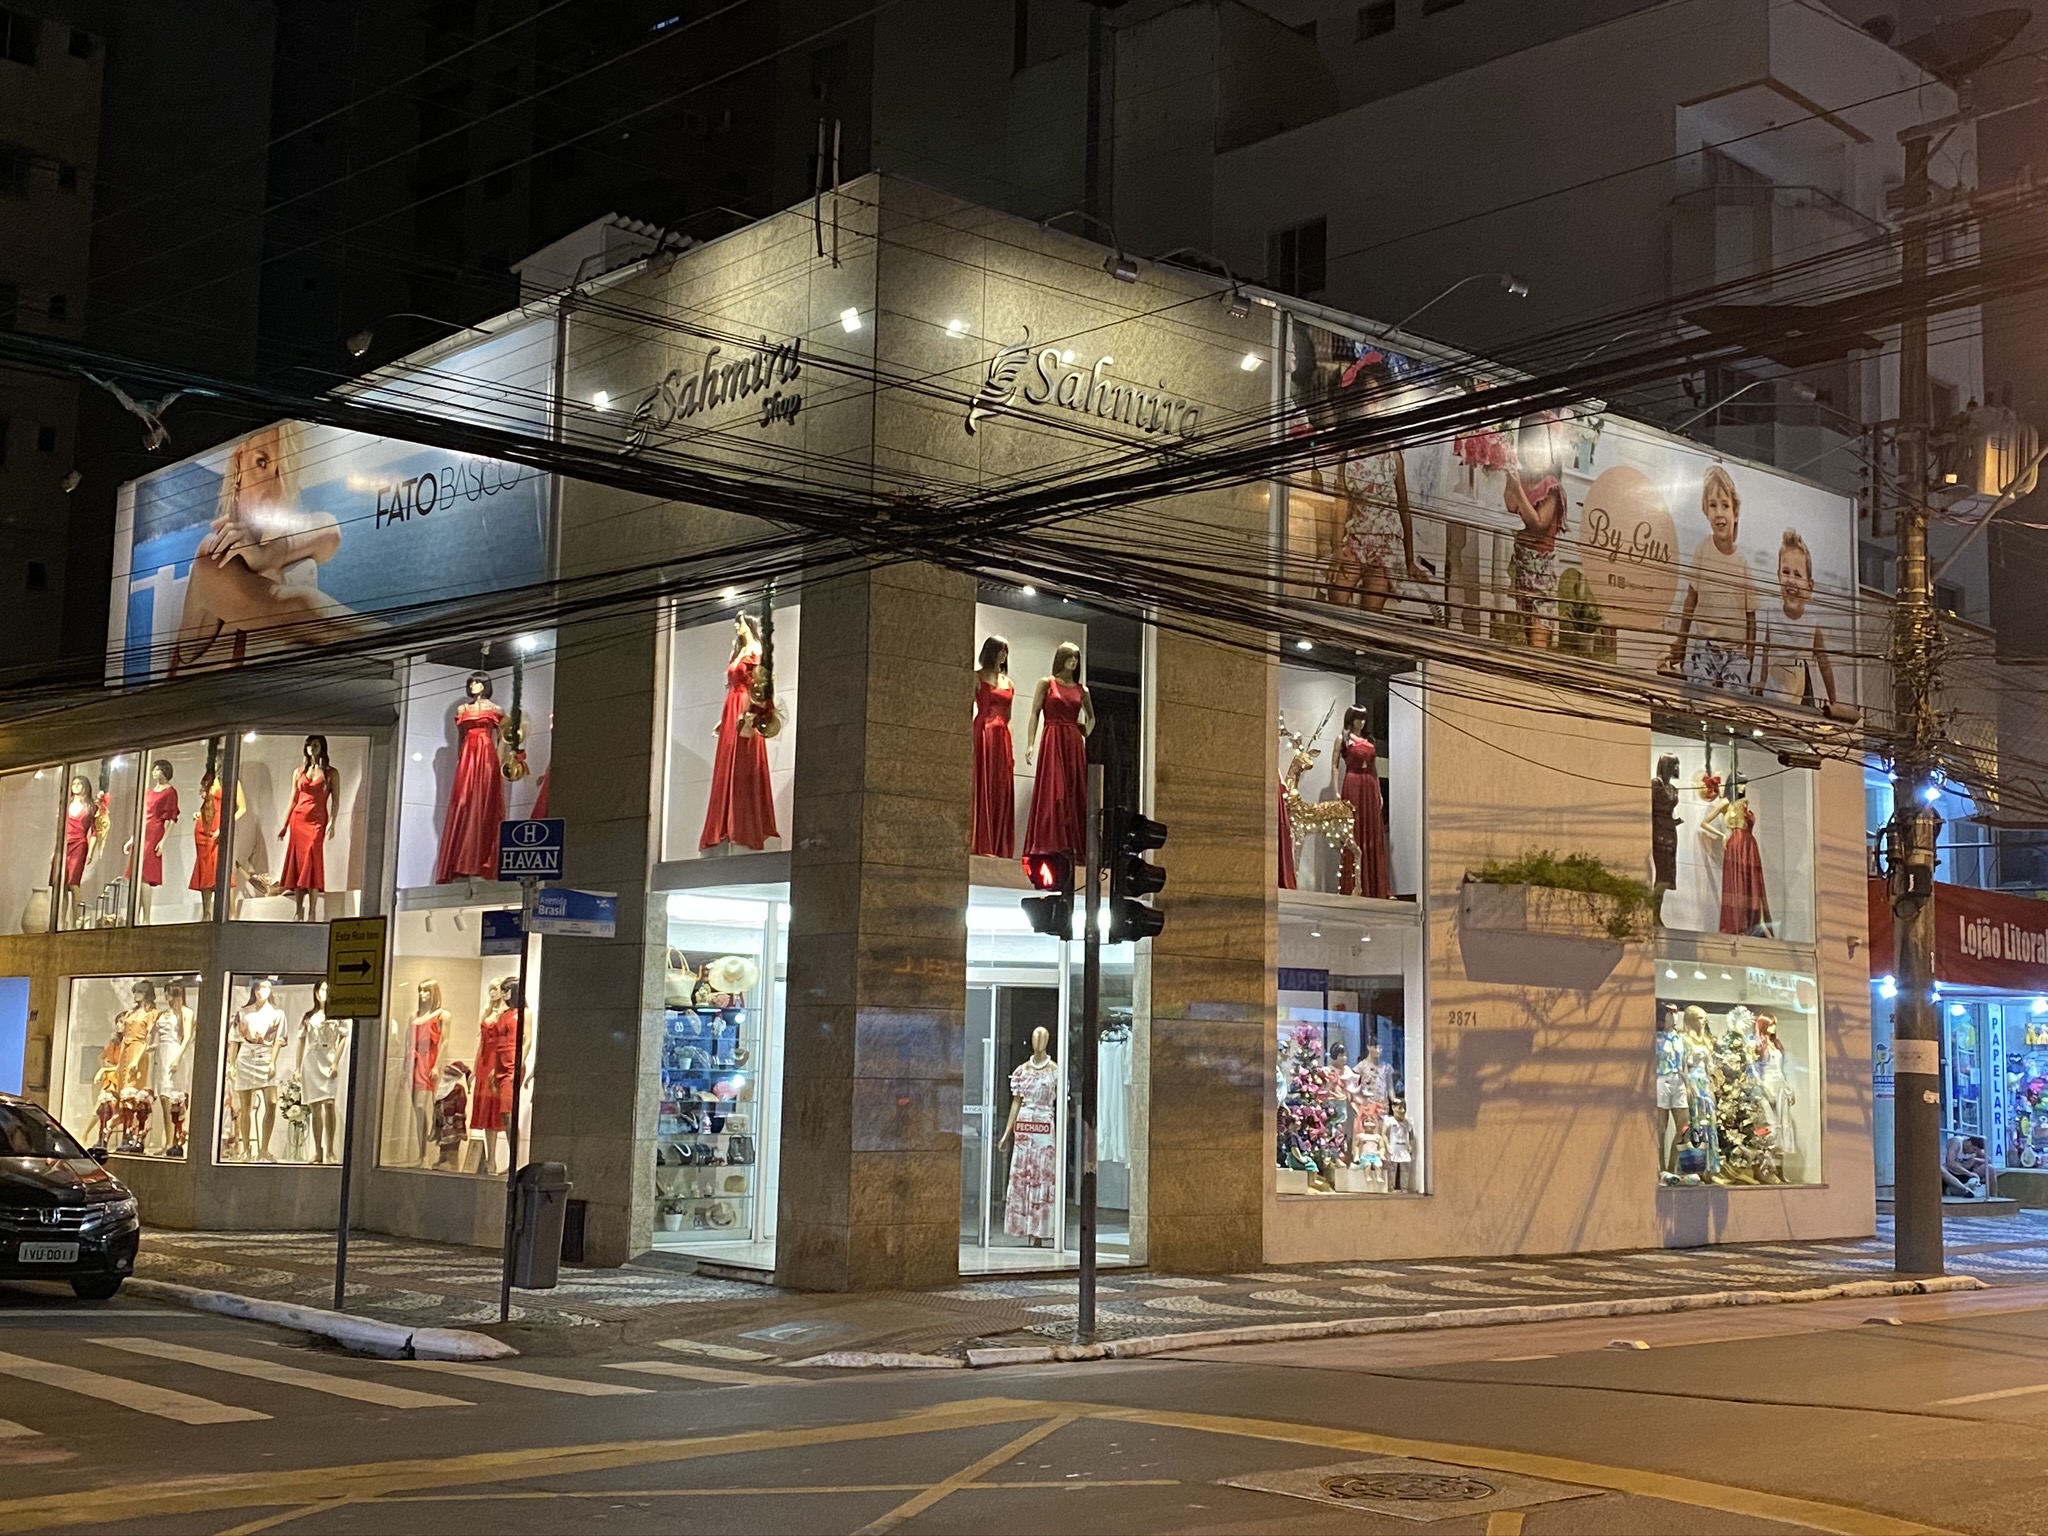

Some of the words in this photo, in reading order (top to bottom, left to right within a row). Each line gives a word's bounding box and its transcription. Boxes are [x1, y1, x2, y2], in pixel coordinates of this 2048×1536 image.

[760, 391, 801, 428] Shop
[1024, 348, 1204, 439] Sahmira
[1588, 508, 1623, 564] By
[1629, 521, 1671, 564] Gus
[501, 851, 559, 869] HAVAN
[538, 904, 566, 916] Brasil
[1959, 914, 2000, 960] Lojão
[1448, 1010, 1477, 1027] 2871
[1991, 1017, 2003, 1156] PAPELARIA
[1016, 1123, 1050, 1132] FECHADO
